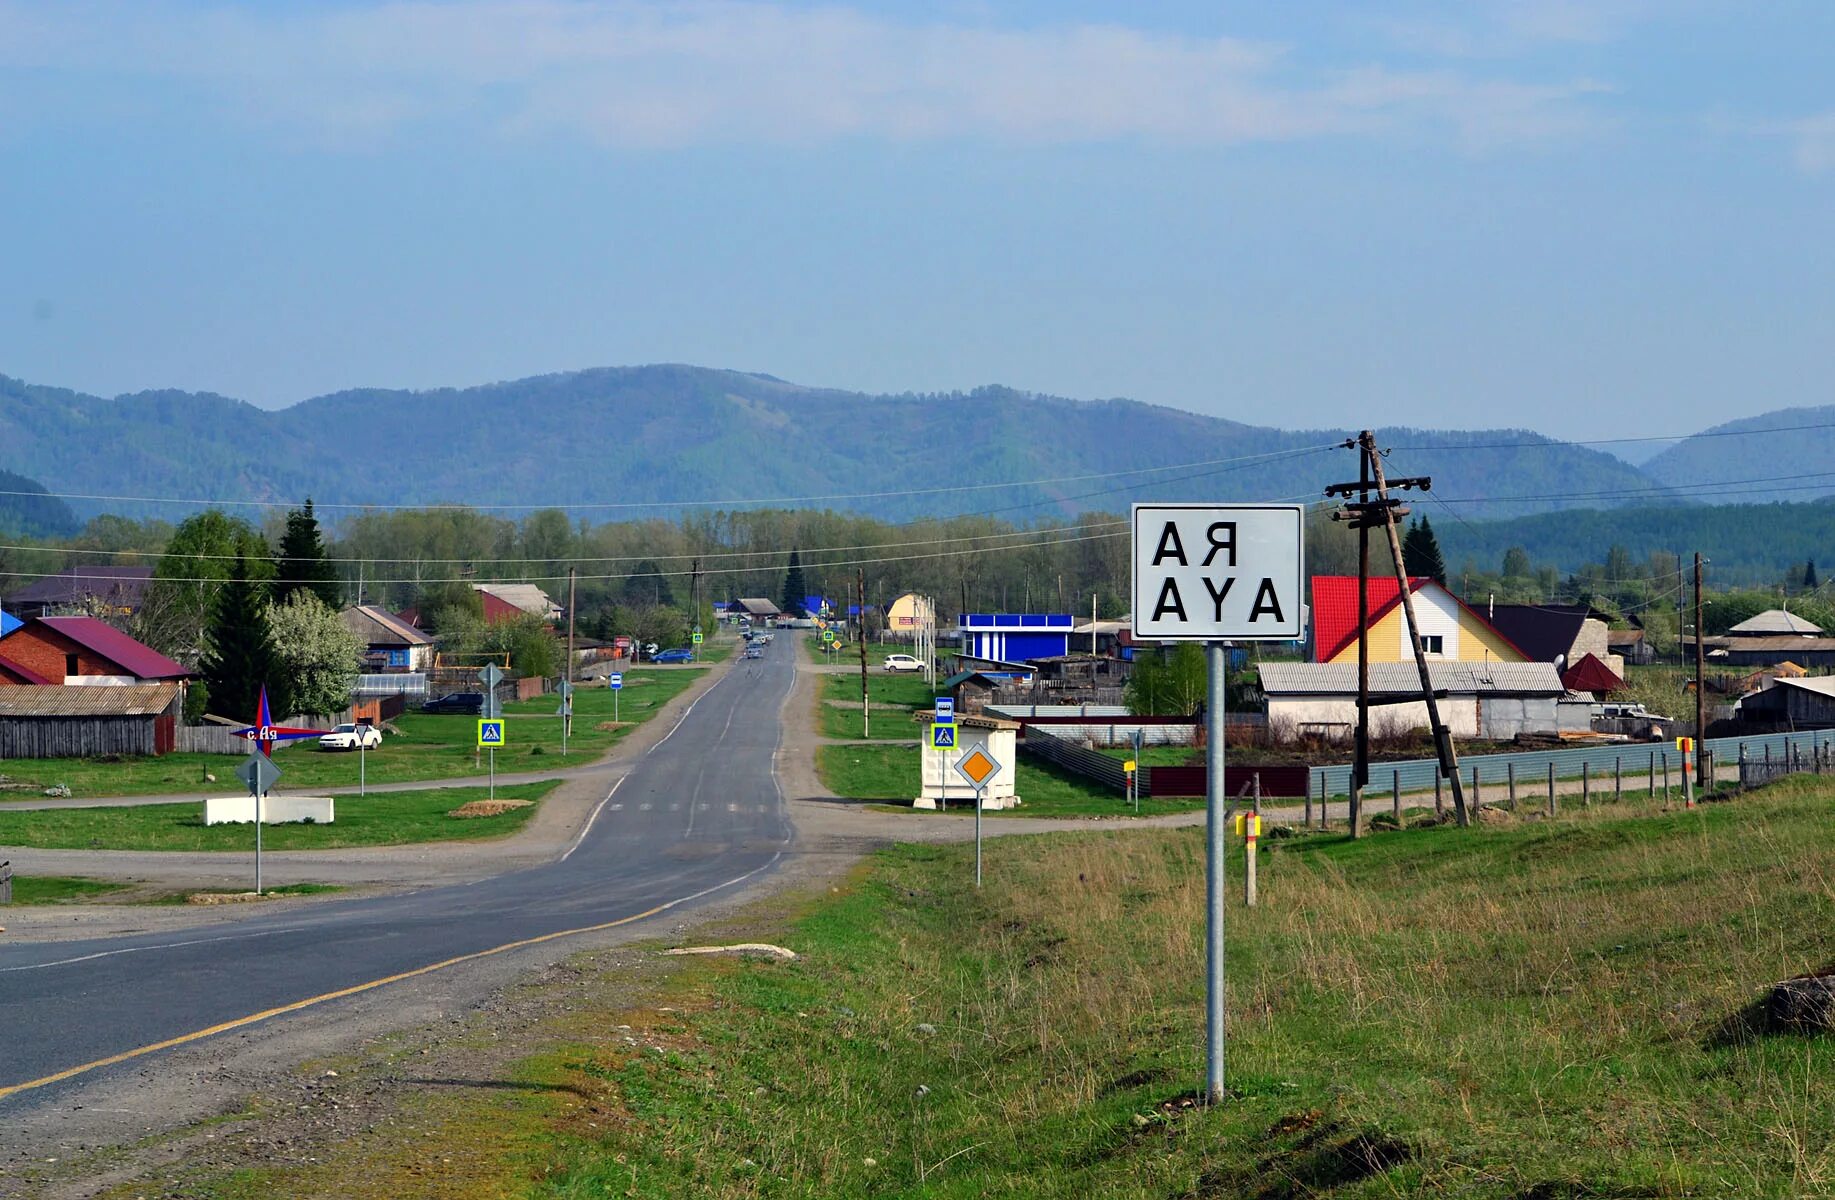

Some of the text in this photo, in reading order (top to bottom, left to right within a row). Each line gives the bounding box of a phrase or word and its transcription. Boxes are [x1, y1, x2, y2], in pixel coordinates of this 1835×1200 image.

[1151, 521, 1237, 567] АЯ
[1151, 577, 1285, 623] AYA
[260, 725, 277, 740] Ая
